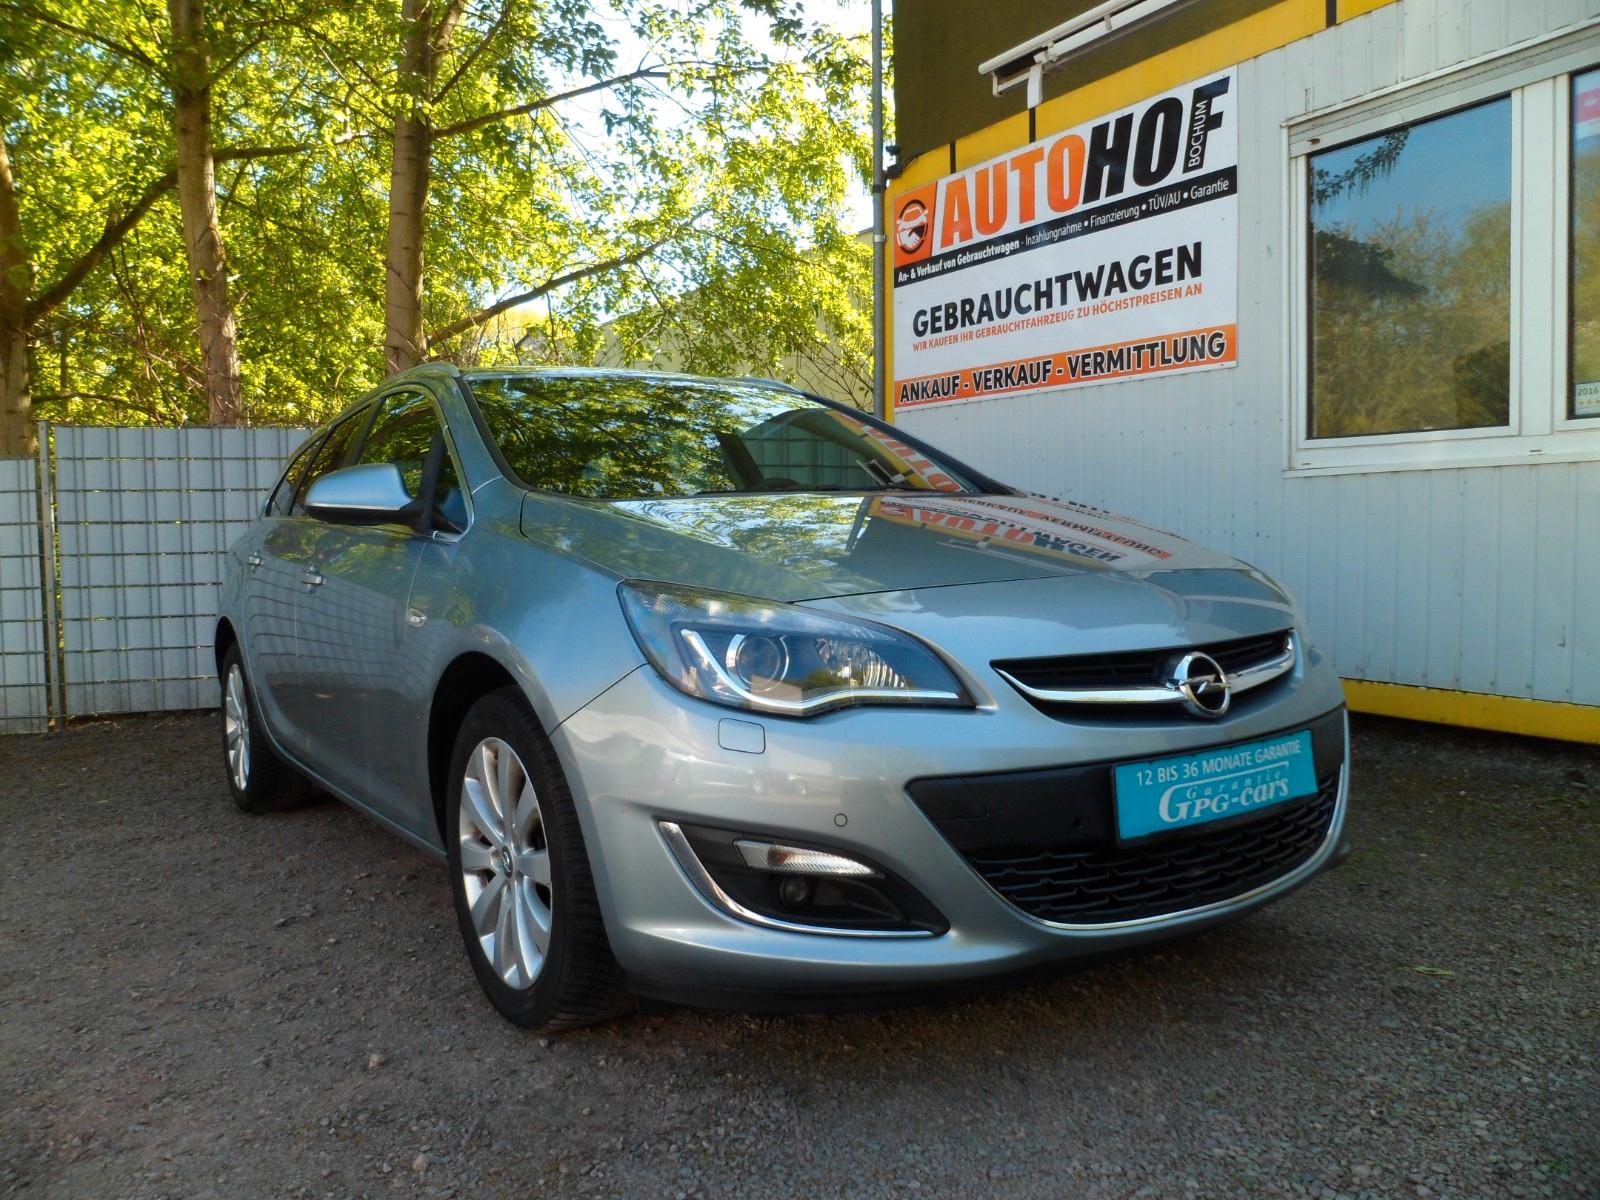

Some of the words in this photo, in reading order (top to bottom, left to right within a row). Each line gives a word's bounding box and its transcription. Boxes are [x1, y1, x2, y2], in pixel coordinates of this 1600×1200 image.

[1188, 99, 1209, 168] BOCHUM
[917, 260, 943, 278] Verkauf
[943, 258, 956, 270] von
[957, 239, 1020, 266] Gebrauchtwagen
[1025, 220, 1083, 246] Inzahlungnahme
[1090, 204, 1140, 229] Finanzierung
[1190, 177, 1230, 200] Garantie
[912, 241, 1202, 338] GEBRAUCHTWAGEN
[912, 339, 927, 352] WIR
[928, 333, 959, 349] KAUFEN
[960, 330, 974, 343] IHR
[975, 310, 1075, 340] GEBRAUCHTFAHRZEUG
[1077, 305, 1090, 319] ZU
[1092, 284, 1183, 316] HÖCHSTPREISEN
[1185, 282, 1203, 297] AN
[899, 374, 961, 403] ANKAUF
[972, 360, 1052, 393] VERKAUF
[1066, 332, 1227, 379] VERMITTLUNG
[1137, 769, 1153, 786] 12
[1157, 766, 1178, 783] BIS
[1182, 761, 1199, 779] 36
[1202, 751, 1252, 774] MONATE
[1255, 739, 1301, 763] GARANTIE
